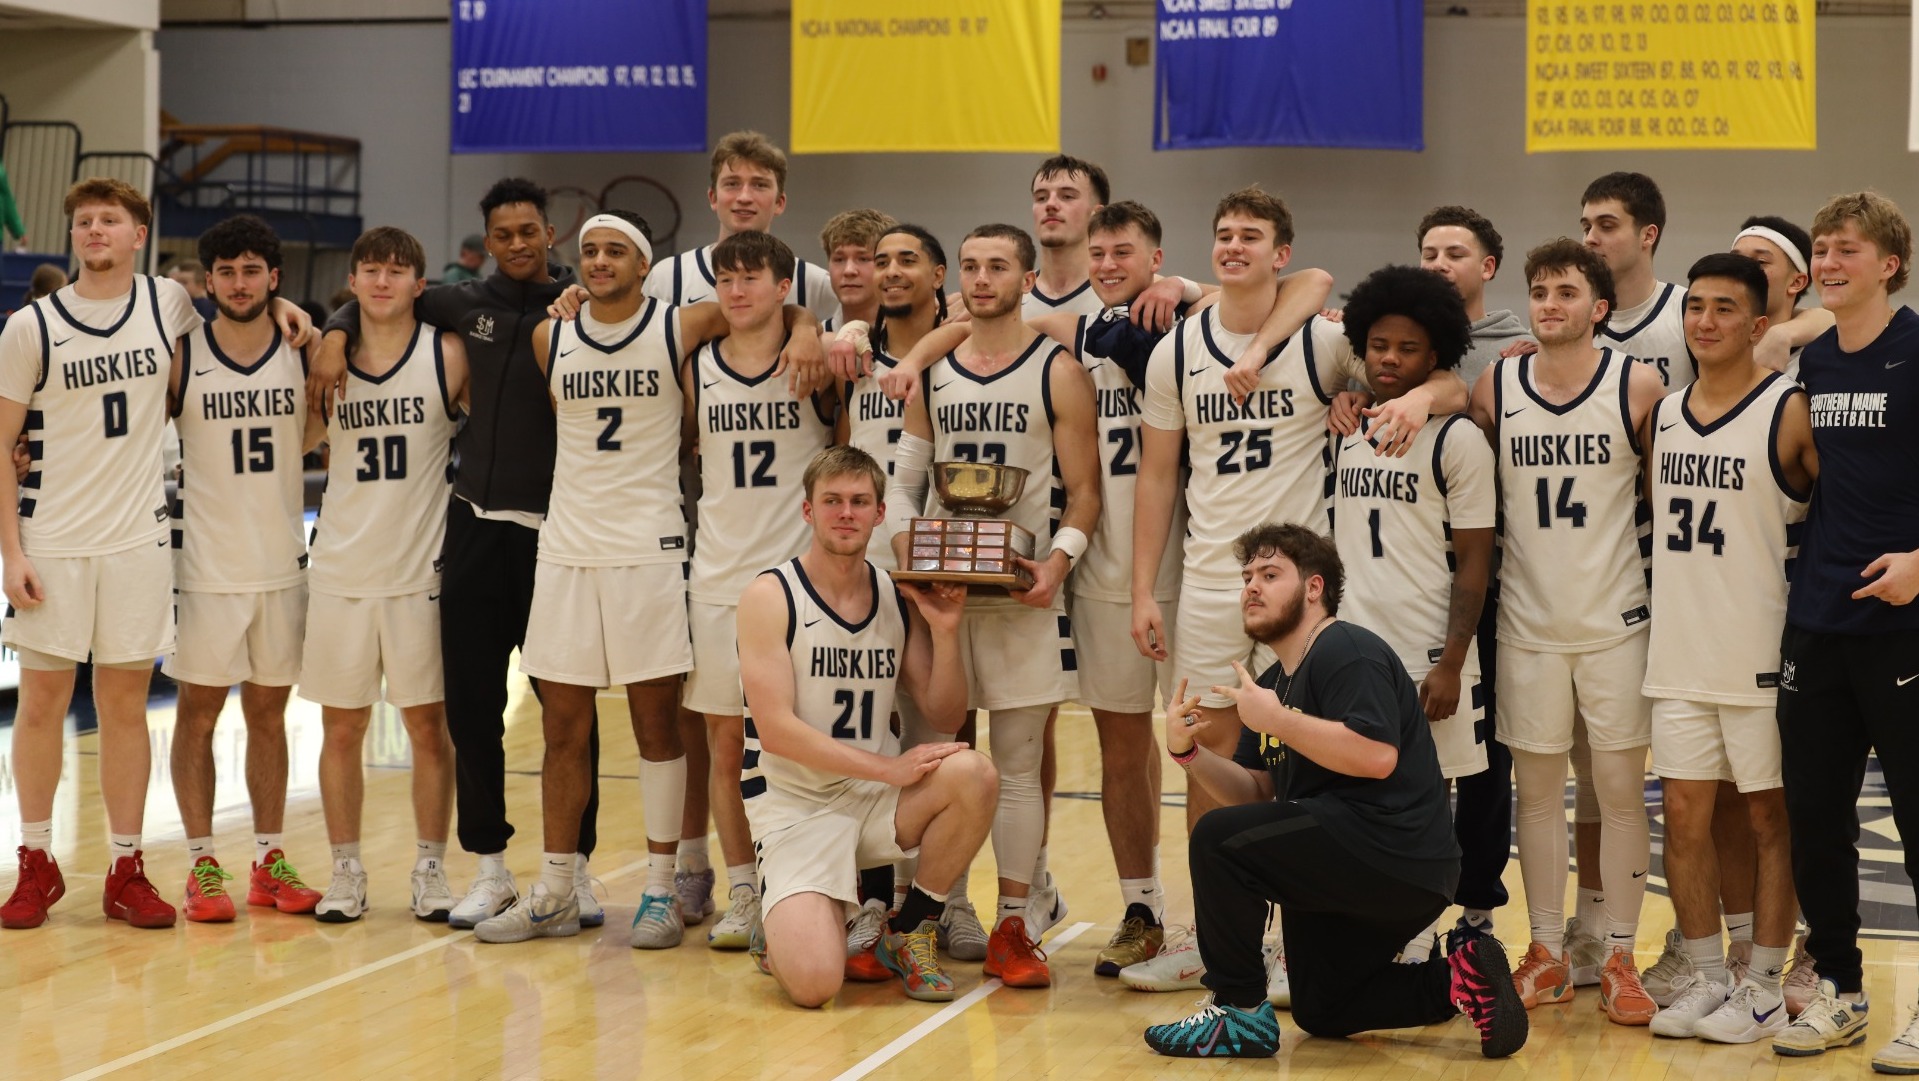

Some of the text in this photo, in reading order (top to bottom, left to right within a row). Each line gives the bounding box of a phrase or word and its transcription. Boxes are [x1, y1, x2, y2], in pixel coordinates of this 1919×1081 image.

[834, 18, 885, 38] NATIONAL
[889, 17, 951, 37] CHAMPIONS
[1160, 18, 1197, 41] NCAA
[1198, 17, 1231, 39] FINAL
[1231, 16, 1260, 38] FOUR
[480, 67, 546, 88] TOURNAMENT
[546, 66, 609, 87] CHAMPIONS
[1535, 62, 1570, 82] NCAA
[1575, 61, 1608, 81] SWEET
[1613, 61, 1656, 81] SIXTEEN
[1533, 118, 1564, 138] NCAA
[1567, 117, 1595, 137] FINAL
[1599, 117, 1626, 137] FOUR
[63, 348, 157, 390] HUSKIES
[563, 370, 659, 400] HUSKIES
[103, 391, 128, 438] 0
[203, 388, 295, 421] HUSKIES
[337, 396, 425, 431] HUSKIES
[709, 402, 800, 434] HUSKIES
[938, 402, 1030, 435] HUSKIES
[1196, 387, 1295, 425] HUSKIES
[1810, 392, 1888, 413] SOUTHERN MAINE
[597, 407, 622, 451] 2
[231, 427, 275, 475] 15
[356, 435, 408, 483] 30
[732, 441, 777, 489] 12
[1107, 427, 1143, 477] 2
[1216, 428, 1274, 476] 25
[1511, 434, 1611, 468] HUSKIES
[1341, 467, 1419, 504] HUSKIES
[1660, 452, 1746, 491] HUSKIES
[1535, 477, 1587, 529] 14
[1368, 509, 1384, 558] 1
[1667, 498, 1725, 556] 34
[811, 646, 895, 679] HUSKIES
[831, 689, 874, 739] 21
